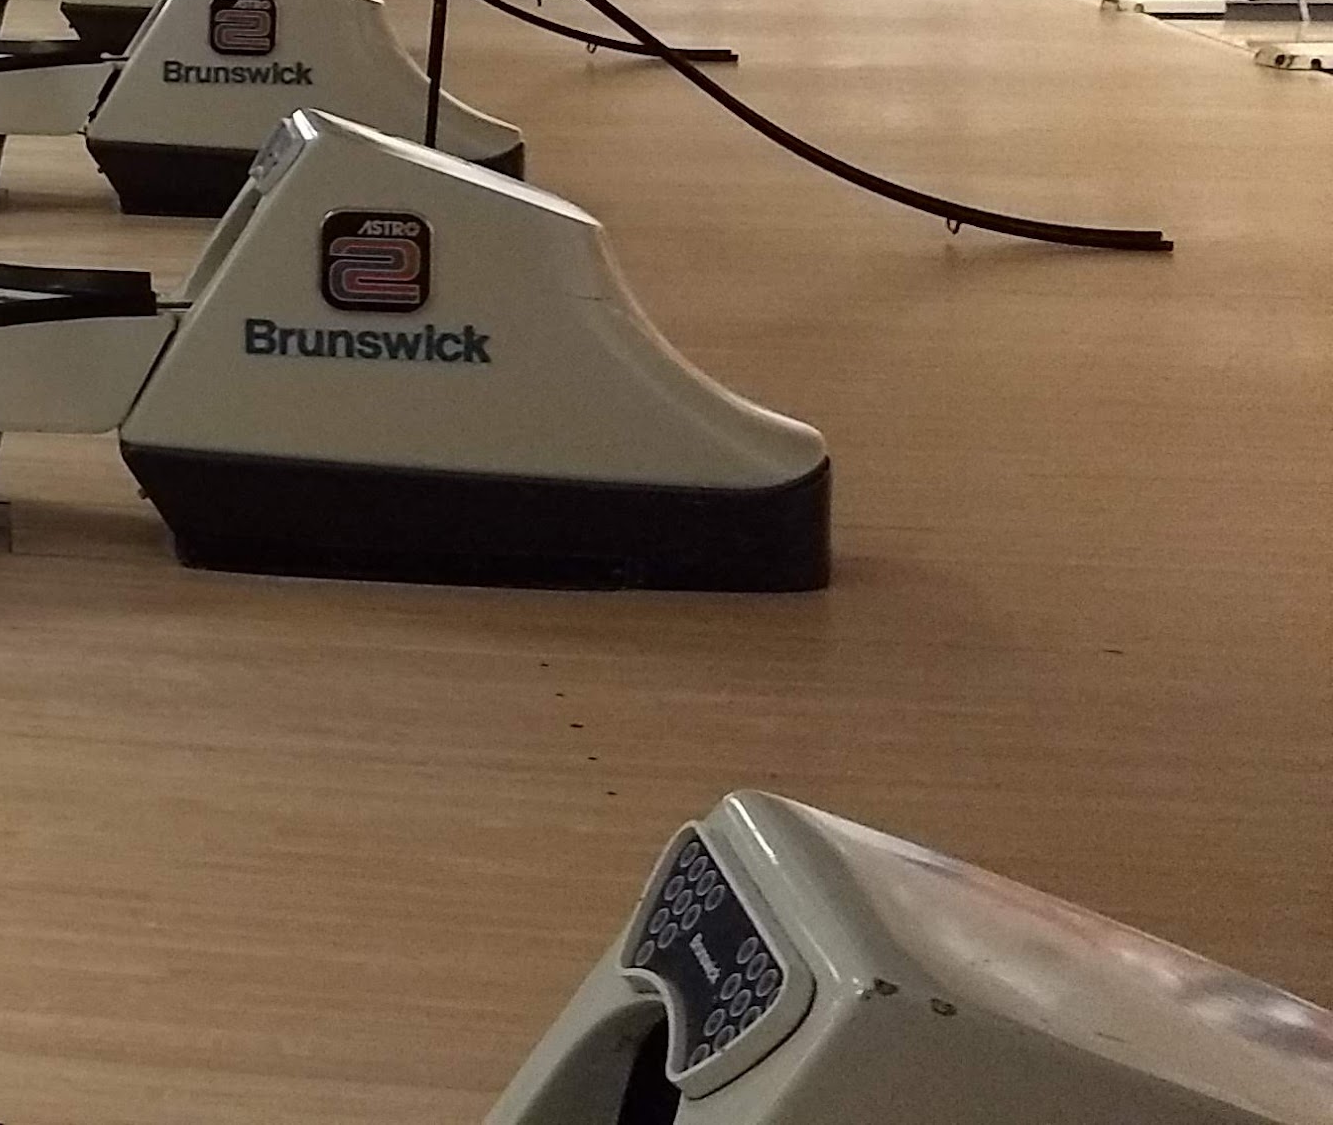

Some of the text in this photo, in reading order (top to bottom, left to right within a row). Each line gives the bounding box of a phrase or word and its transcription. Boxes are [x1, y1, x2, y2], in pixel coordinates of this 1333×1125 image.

[163, 60, 314, 85] Brunswick
[357, 220, 421, 237] ASTRO
[245, 318, 492, 363] Brunswick
